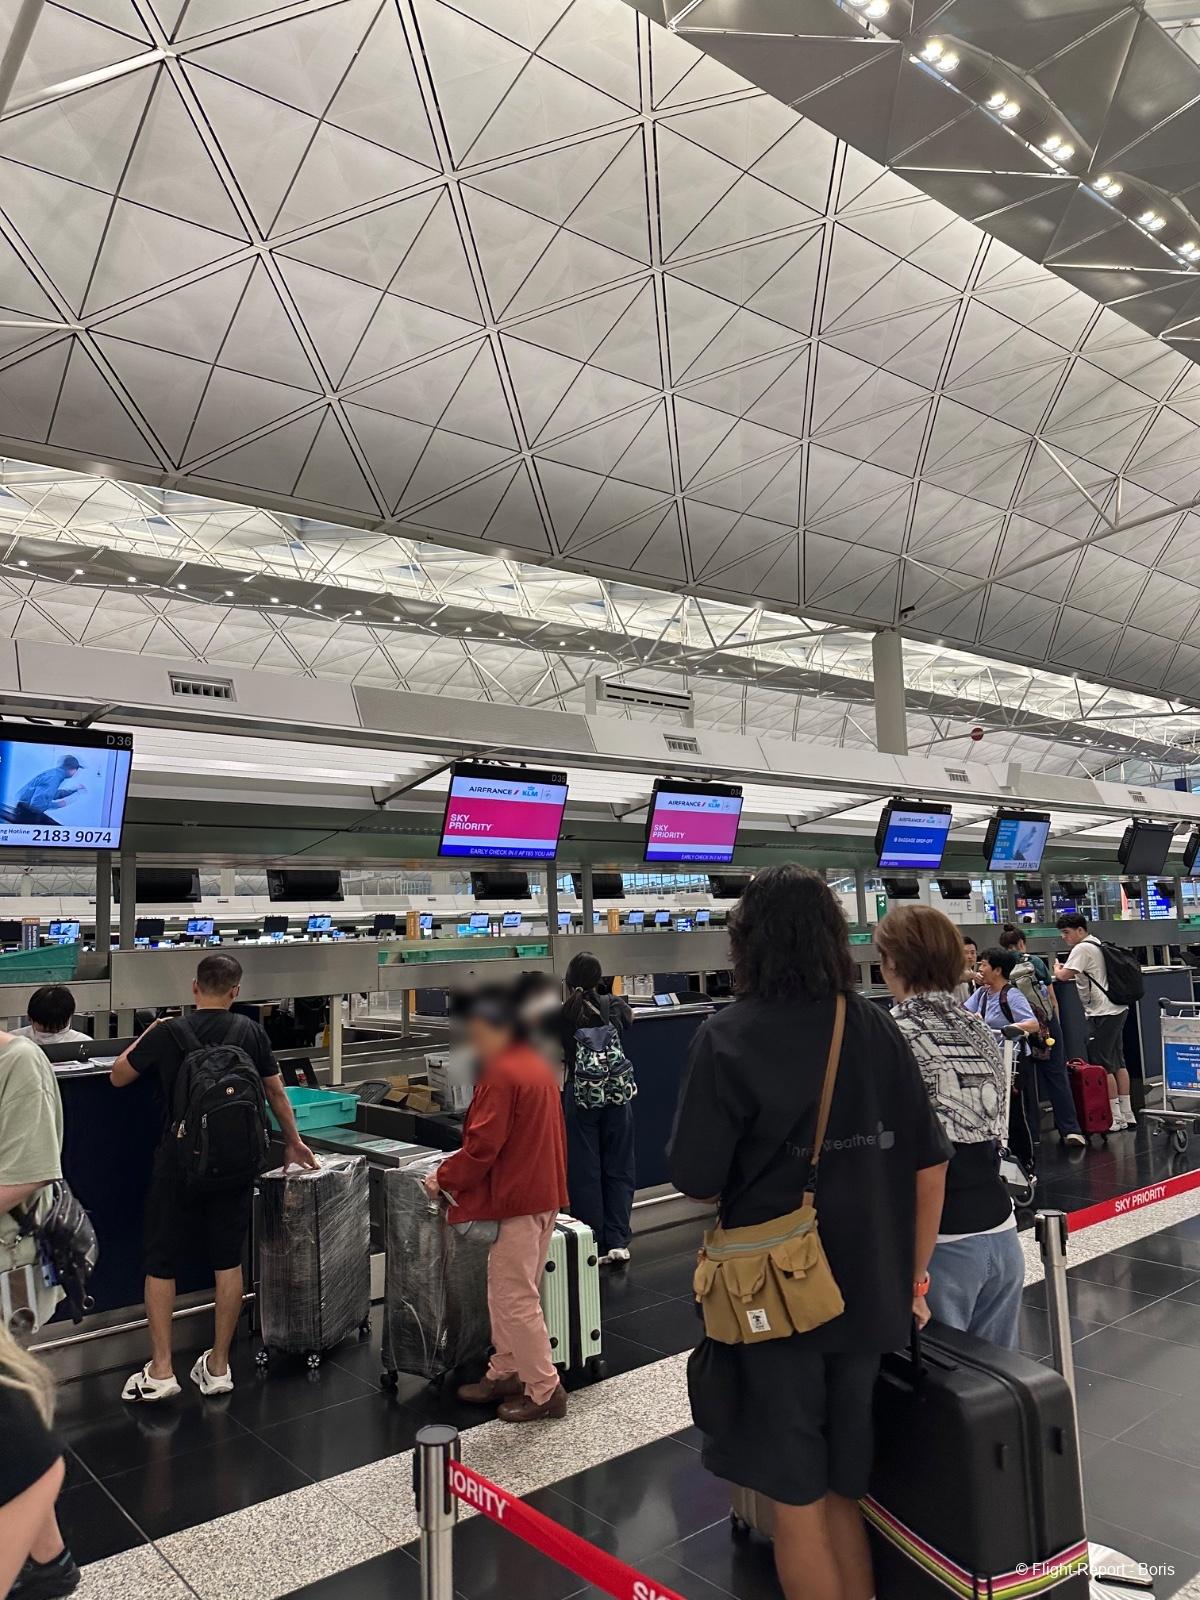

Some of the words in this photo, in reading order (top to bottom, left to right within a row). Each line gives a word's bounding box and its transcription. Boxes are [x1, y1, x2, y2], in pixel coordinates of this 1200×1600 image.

[450, 813, 470, 822] SKY
[448, 821, 492, 831] PRIORITY
[32, 829, 70, 842] 2183
[75, 830, 112, 844] 9074
[652, 831, 685, 839] PRIORITY
[1115, 1200, 1130, 1213] SKY
[1132, 1185, 1166, 1207] PRIORITY
